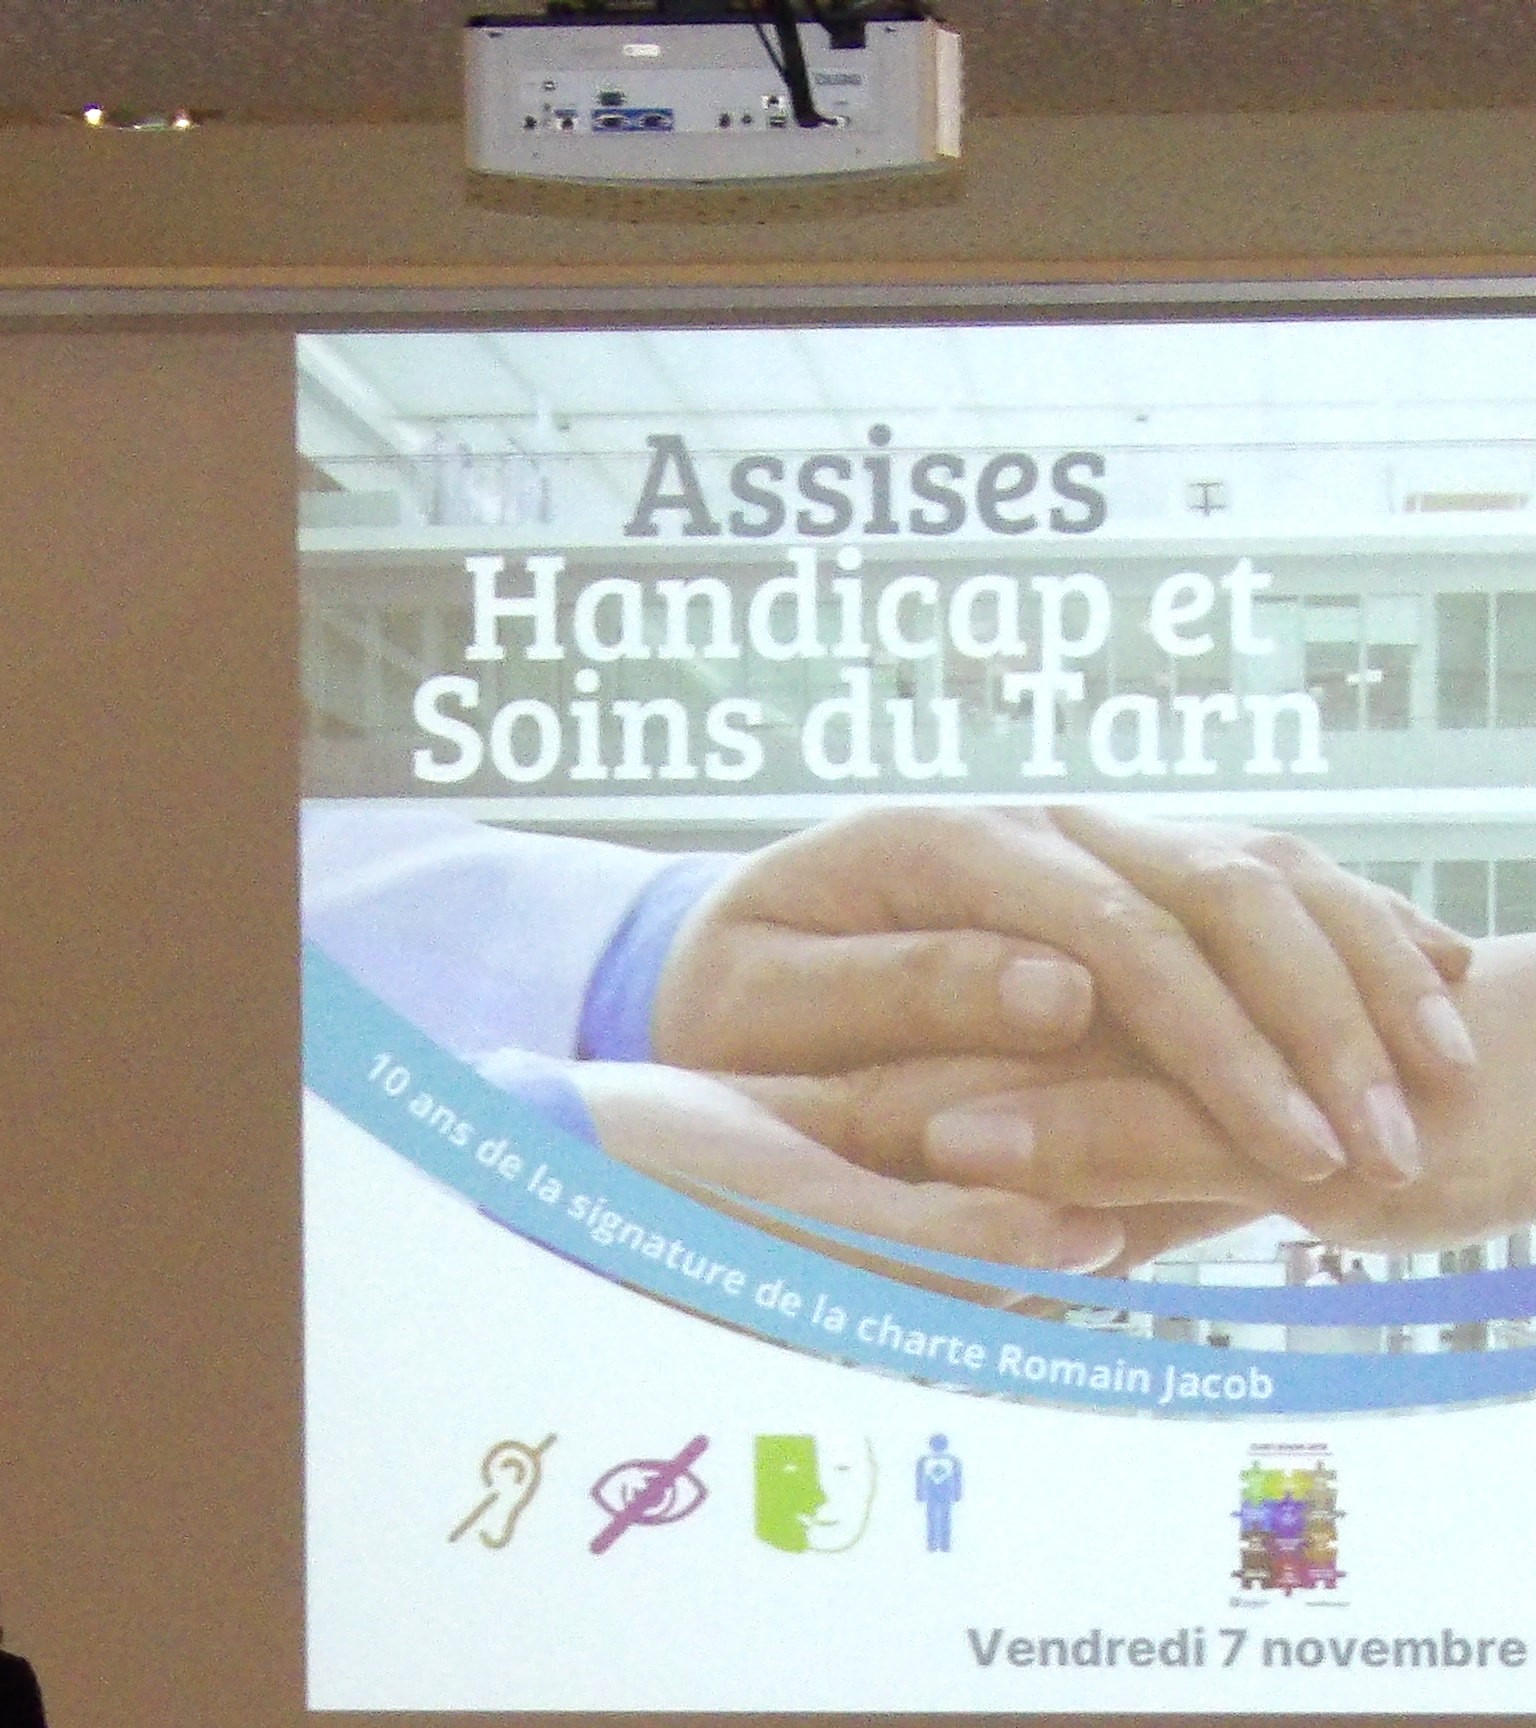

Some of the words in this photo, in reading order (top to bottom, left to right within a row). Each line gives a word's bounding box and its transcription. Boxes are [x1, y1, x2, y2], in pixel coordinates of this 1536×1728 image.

[623, 423, 1108, 538] Assises
[464, 547, 1109, 684] Handicap
[1148, 556, 1272, 657] et
[411, 667, 766, 785] Soins
[800, 667, 968, 781] du
[1003, 671, 1329, 779] Tarn
[366, 1051, 412, 1097] 10
[407, 1090, 472, 1148] ans
[475, 1134, 526, 1181] de
[526, 1164, 564, 1206] la
[566, 1193, 748, 1298] signature
[755, 1277, 804, 1318] de
[812, 1290, 848, 1332] la
[857, 1312, 988, 1370] charte
[997, 1342, 1151, 1396] Romain
[1159, 1362, 1276, 1404] Jacob
[967, 1625, 1206, 1669] Vendredi
[1216, 1627, 1244, 1668] 7
[1261, 1625, 1528, 1669] novembre
